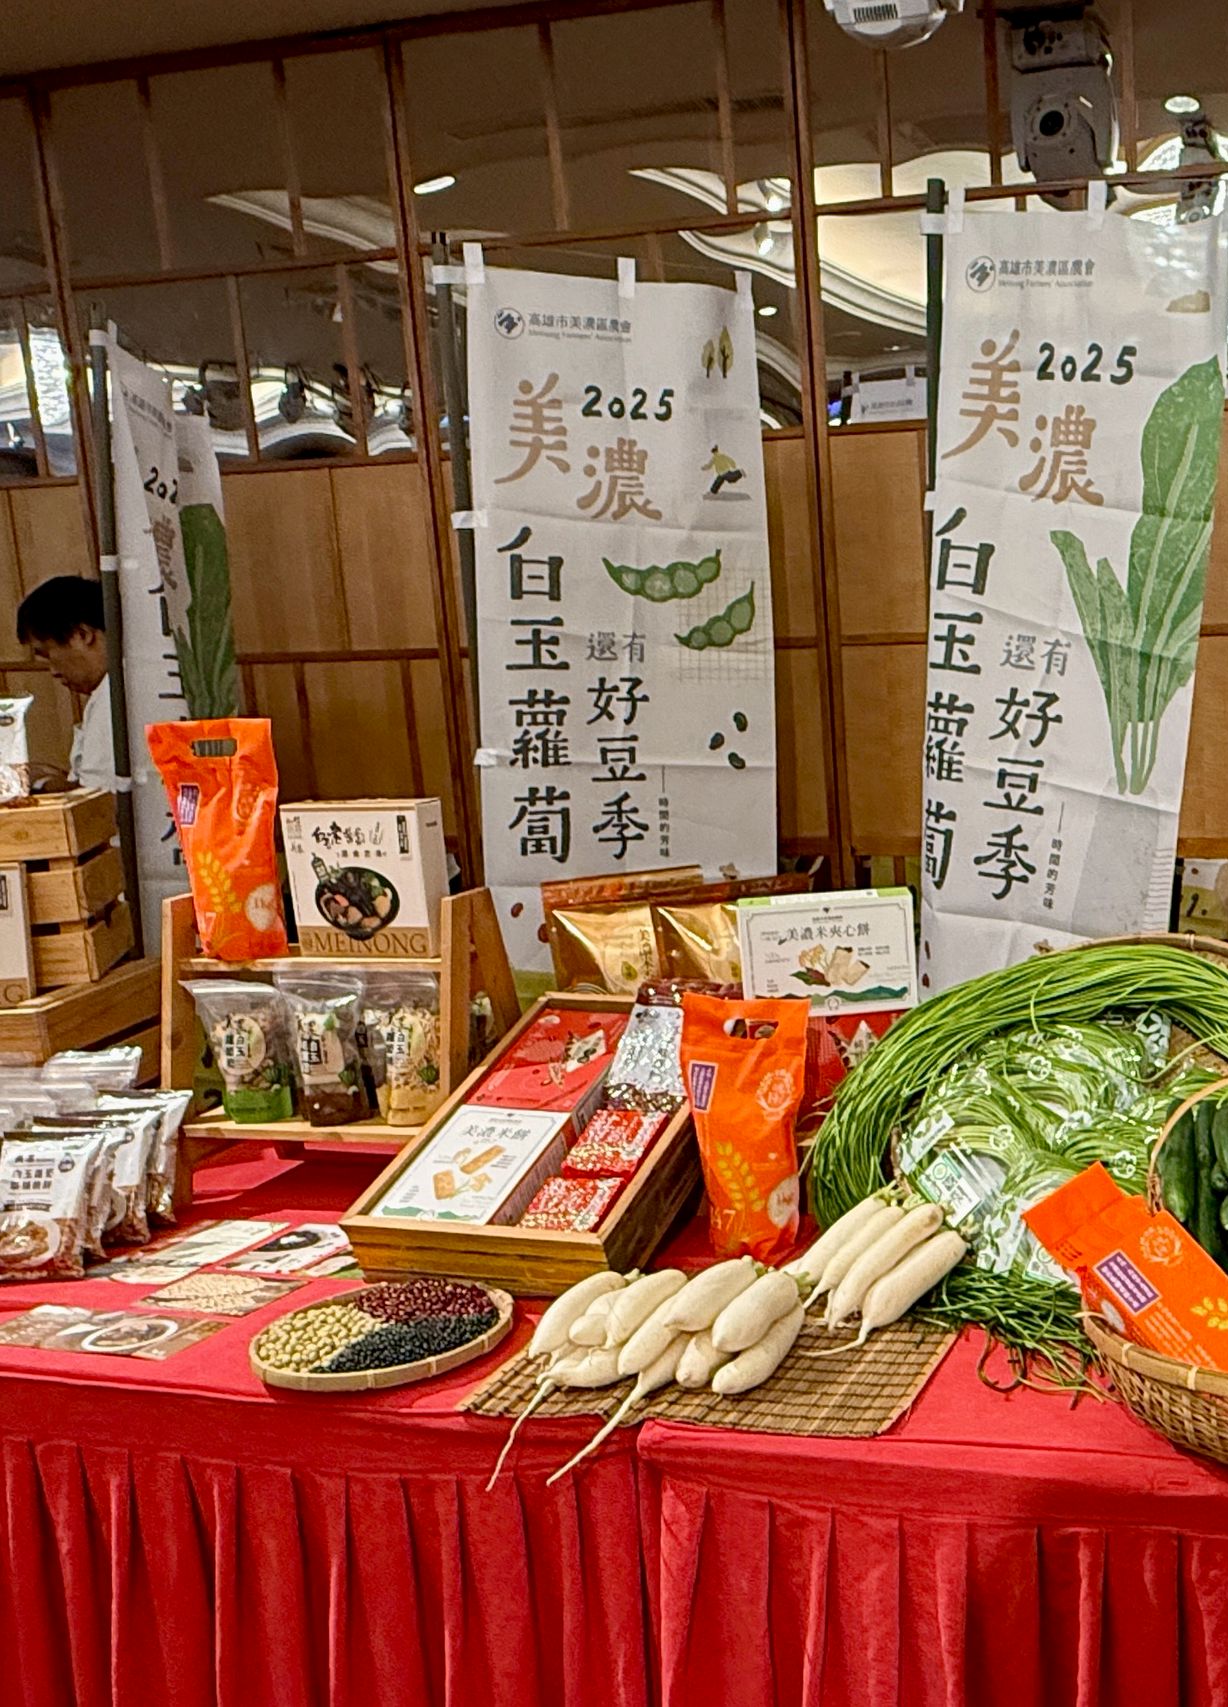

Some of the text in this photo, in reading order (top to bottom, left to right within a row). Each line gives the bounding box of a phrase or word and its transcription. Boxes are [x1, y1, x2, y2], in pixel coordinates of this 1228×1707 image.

[581, 385, 674, 421] 2025
[1036, 342, 1137, 385] 2025
[494, 373, 663, 521] 美濃
[941, 328, 1104, 506] 美濃
[497, 526, 572, 863] 白玉蘿蔔
[586, 631, 646, 663] 還有
[1000, 633, 1072, 676] 還有
[586, 677, 650, 859] 好豆季
[973, 687, 1063, 900] 好豆季
[314, 931, 428, 954] MEINONG
